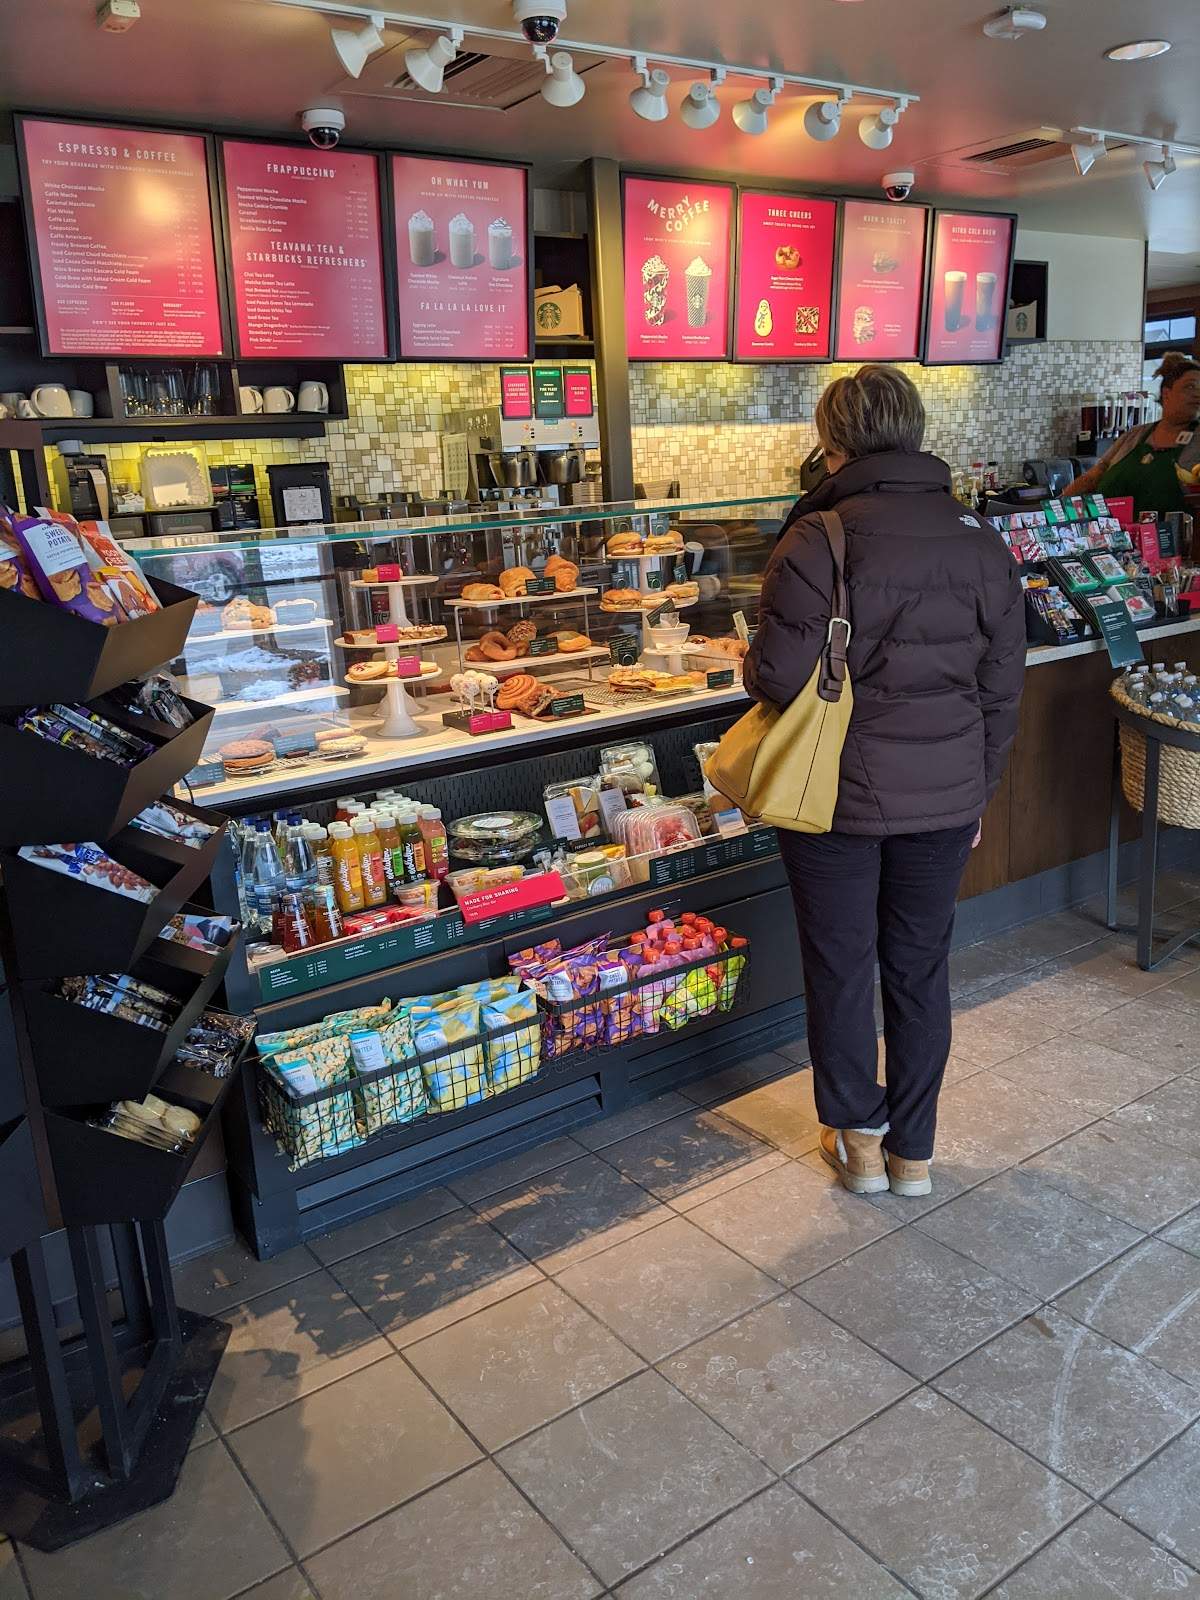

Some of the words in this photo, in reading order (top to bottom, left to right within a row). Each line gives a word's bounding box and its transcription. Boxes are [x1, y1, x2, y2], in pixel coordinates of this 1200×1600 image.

[58, 142, 117, 157] ESPRESSO
[124, 148, 130, 158] &
[136, 150, 177, 162] COFFEE
[431, 176, 442, 185] OH
[446, 178, 468, 188] WHAT
[472, 181, 489, 190] YUM
[647, 195, 690, 219] MERRY
[768, 209, 787, 218] THREE
[789, 211, 812, 220] CHEERS
[665, 200, 710, 232] COFFEE
[270, 240, 312, 252] TEAVANA
[317, 244, 334, 255] TEA
[338, 245, 345, 255] &
[246, 252, 303, 264] STARBUCKS
[307, 255, 366, 268] REFRESHERS
[434, 302, 444, 311] LA
[448, 303, 457, 311] LA
[461, 303, 471, 312] LA
[474, 304, 495, 313] LOVE
[498, 304, 506, 313] IT
[44, 528, 66, 540] SWEET
[48, 535, 73, 548] POTATO
[464, 897, 481, 906] MADE
[494, 887, 519, 898] SHARING
